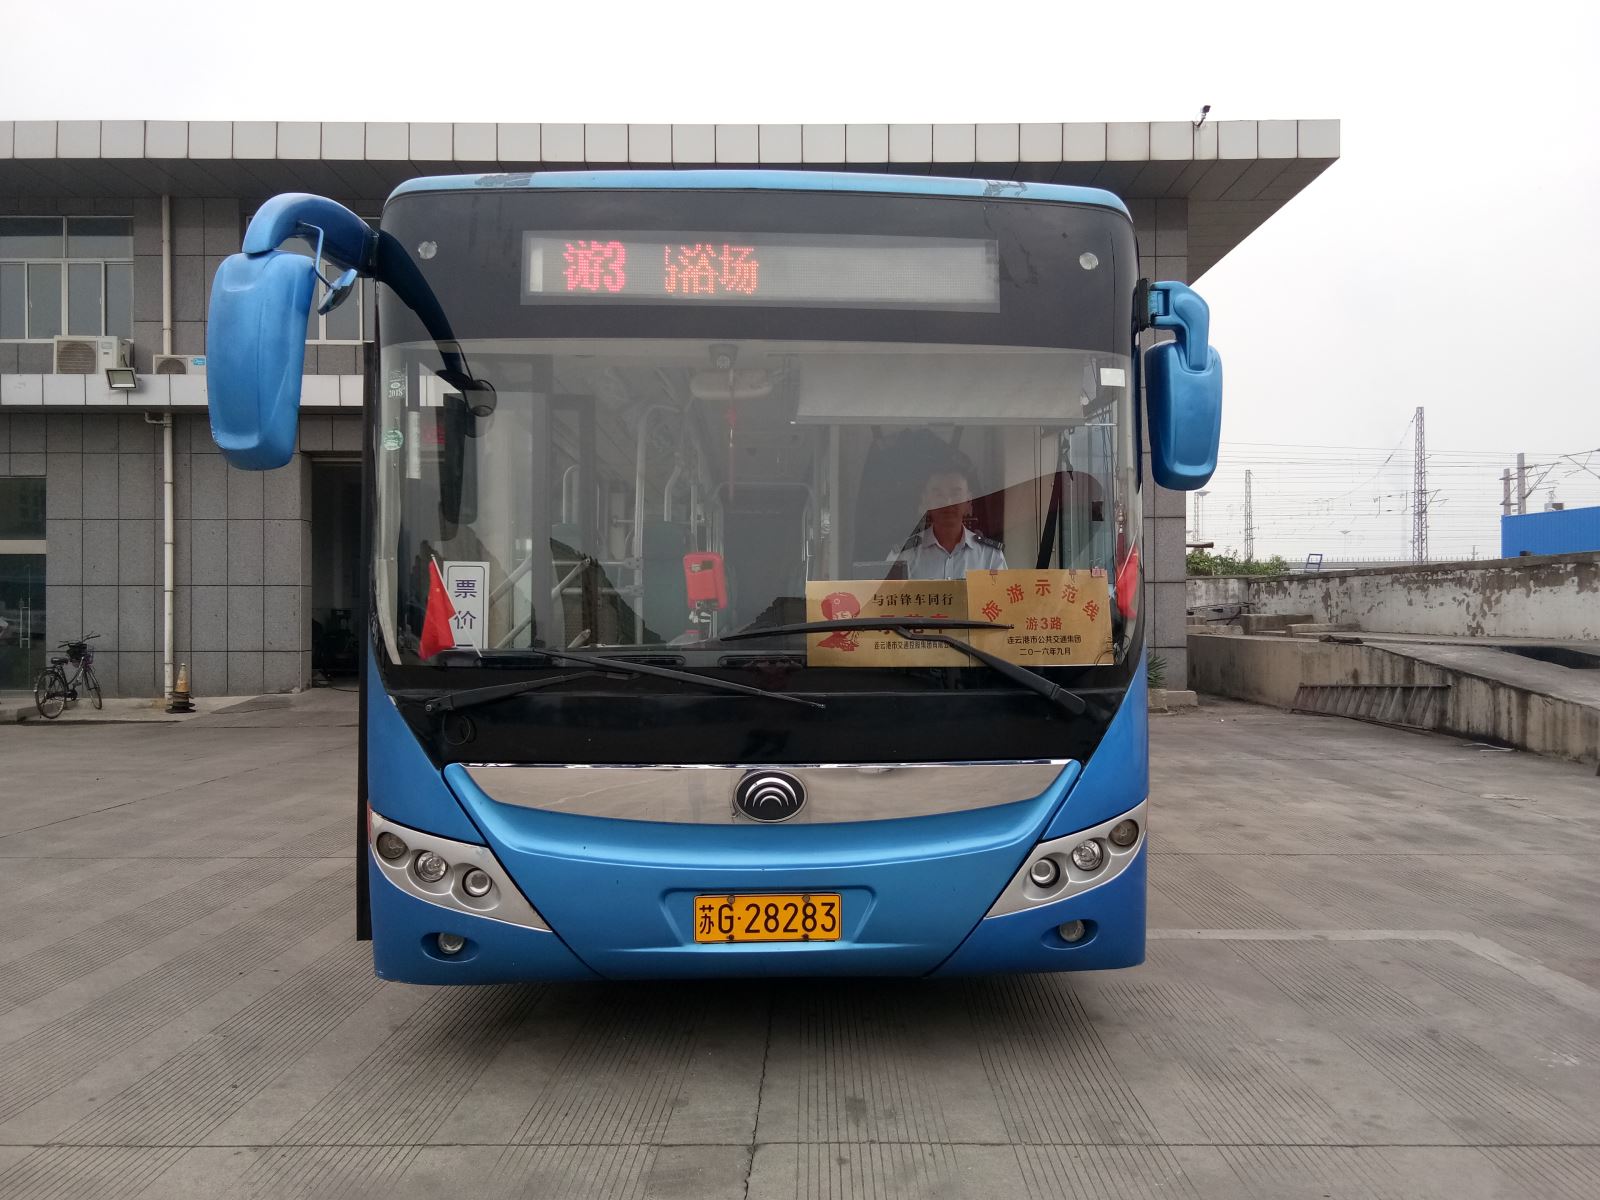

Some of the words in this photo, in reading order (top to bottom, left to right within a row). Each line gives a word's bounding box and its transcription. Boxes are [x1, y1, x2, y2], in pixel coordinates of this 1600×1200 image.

[664, 243, 759, 295] 浴场
[454, 579, 477, 630] 票价
[872, 593, 953, 607] 与雷锋车同行
[981, 579, 1100, 623] 旅游示范线
[1025, 616, 1063, 631] 游3路
[1007, 634, 1082, 645] 连云港市公共交通集团
